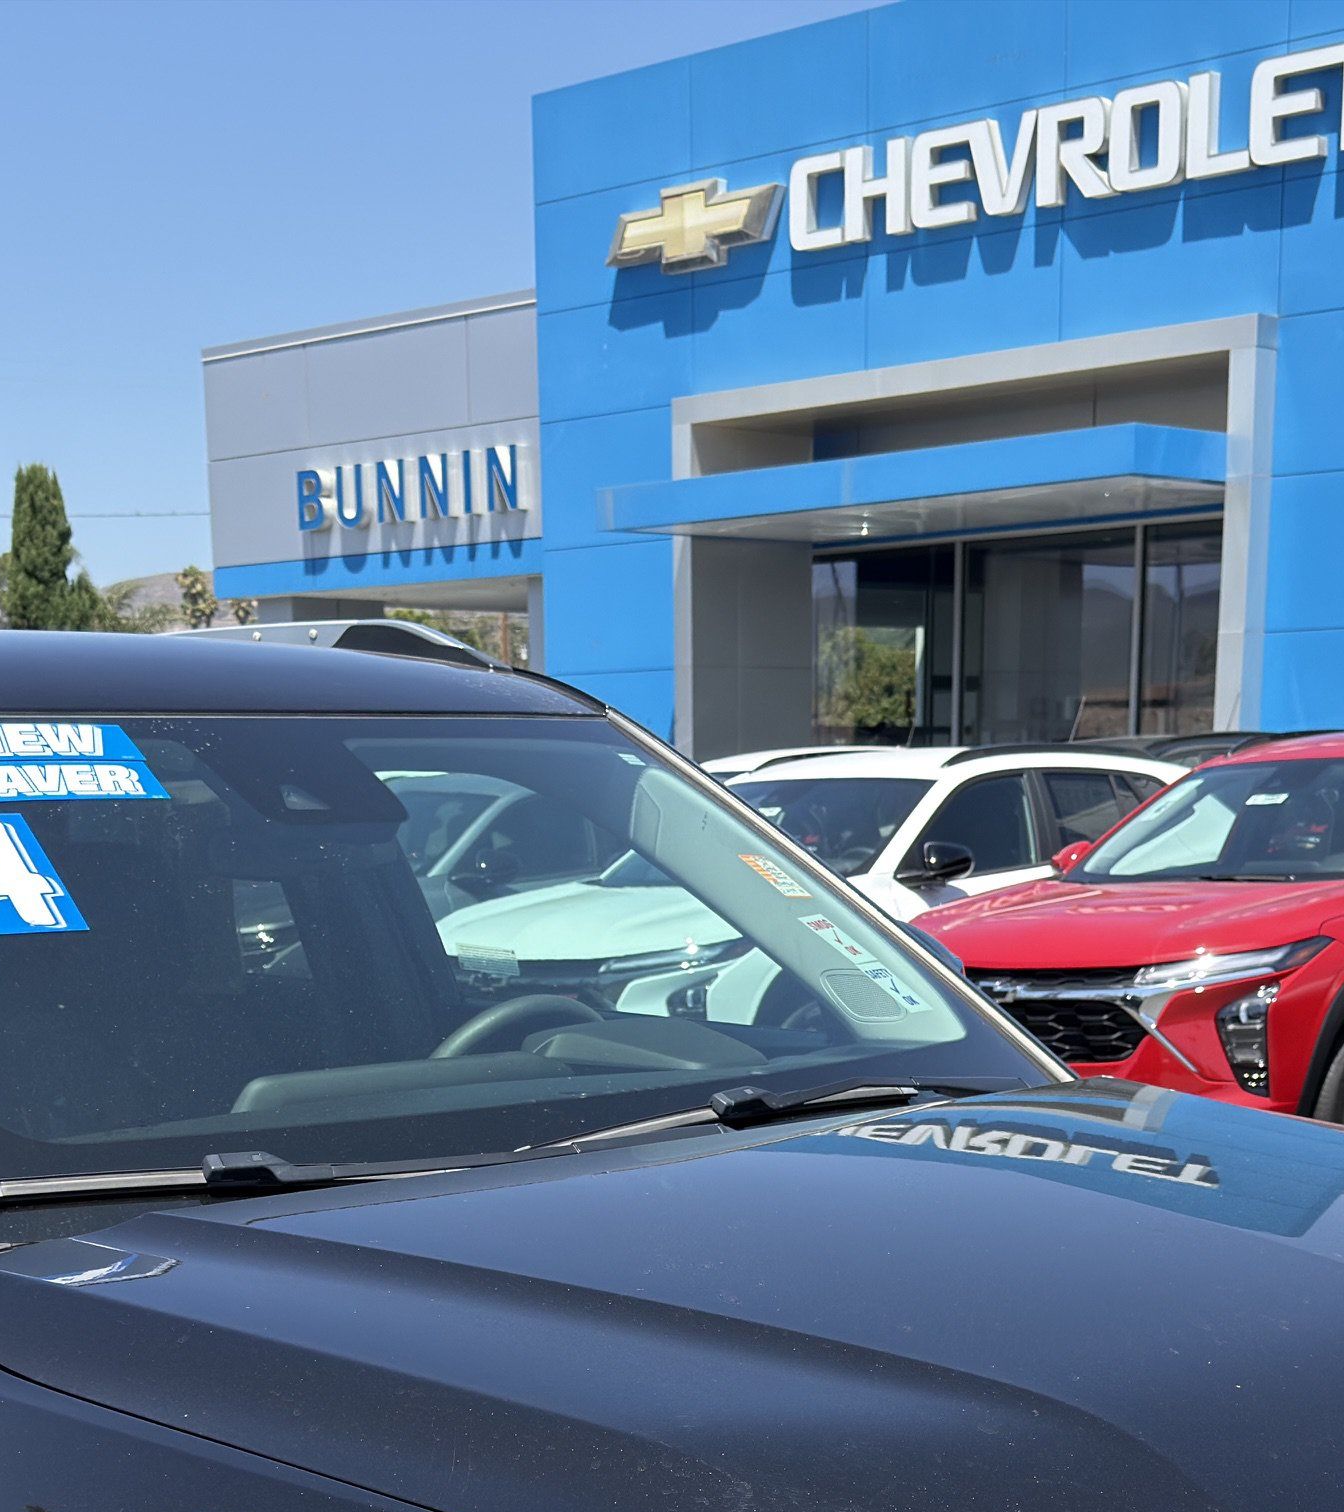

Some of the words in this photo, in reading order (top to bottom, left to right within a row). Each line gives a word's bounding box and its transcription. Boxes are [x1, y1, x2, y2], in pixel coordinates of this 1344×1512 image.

[296, 444, 518, 531] BUNNIN
[807, 919, 834, 931] SMOG
[864, 967, 893, 980] SAFETY
[902, 995, 920, 1006] OK
